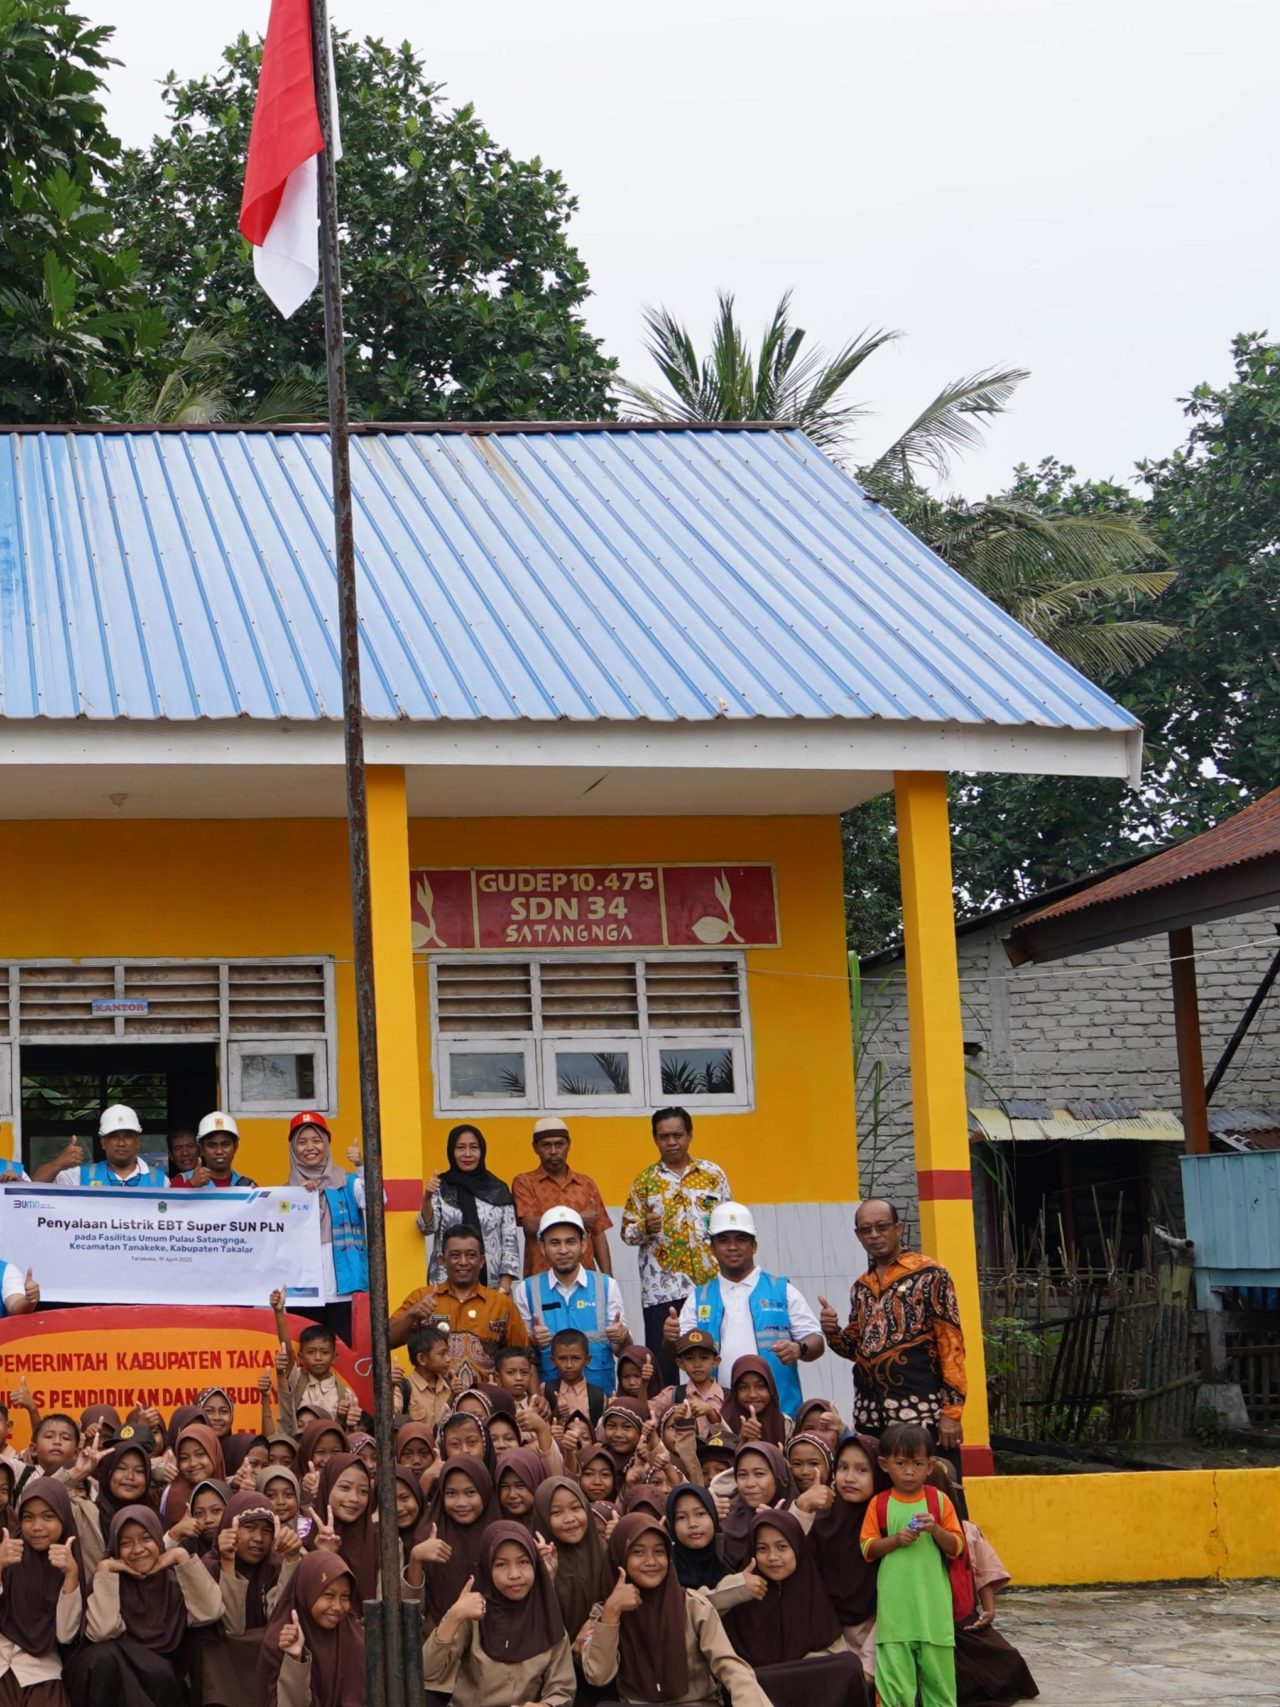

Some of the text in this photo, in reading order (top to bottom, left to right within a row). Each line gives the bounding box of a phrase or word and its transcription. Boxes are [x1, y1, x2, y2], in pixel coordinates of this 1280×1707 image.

[479, 871, 655, 893] GUDEP 10.475
[510, 896, 629, 921] SDN 34
[505, 924, 634, 943] SATANGNGA
[95, 1003, 145, 1012] KANTOR
[37, 1216, 285, 1234] Penyalaan Listrik EBT Super SUN PLN
[74, 1233, 97, 1242] pada
[98, 1233, 137, 1242] Fasilitas
[138, 1234, 168, 1242] Umum
[169, 1235, 195, 1243] Pulau
[69, 1242, 121, 1251] Kecamatan
[170, 1244, 219, 1254] Kabupaten
[221, 1245, 254, 1253] Takalar
[116, 1350, 222, 1371] KABUPATEN
[49, 1388, 160, 1409] PENDIDIKAN
